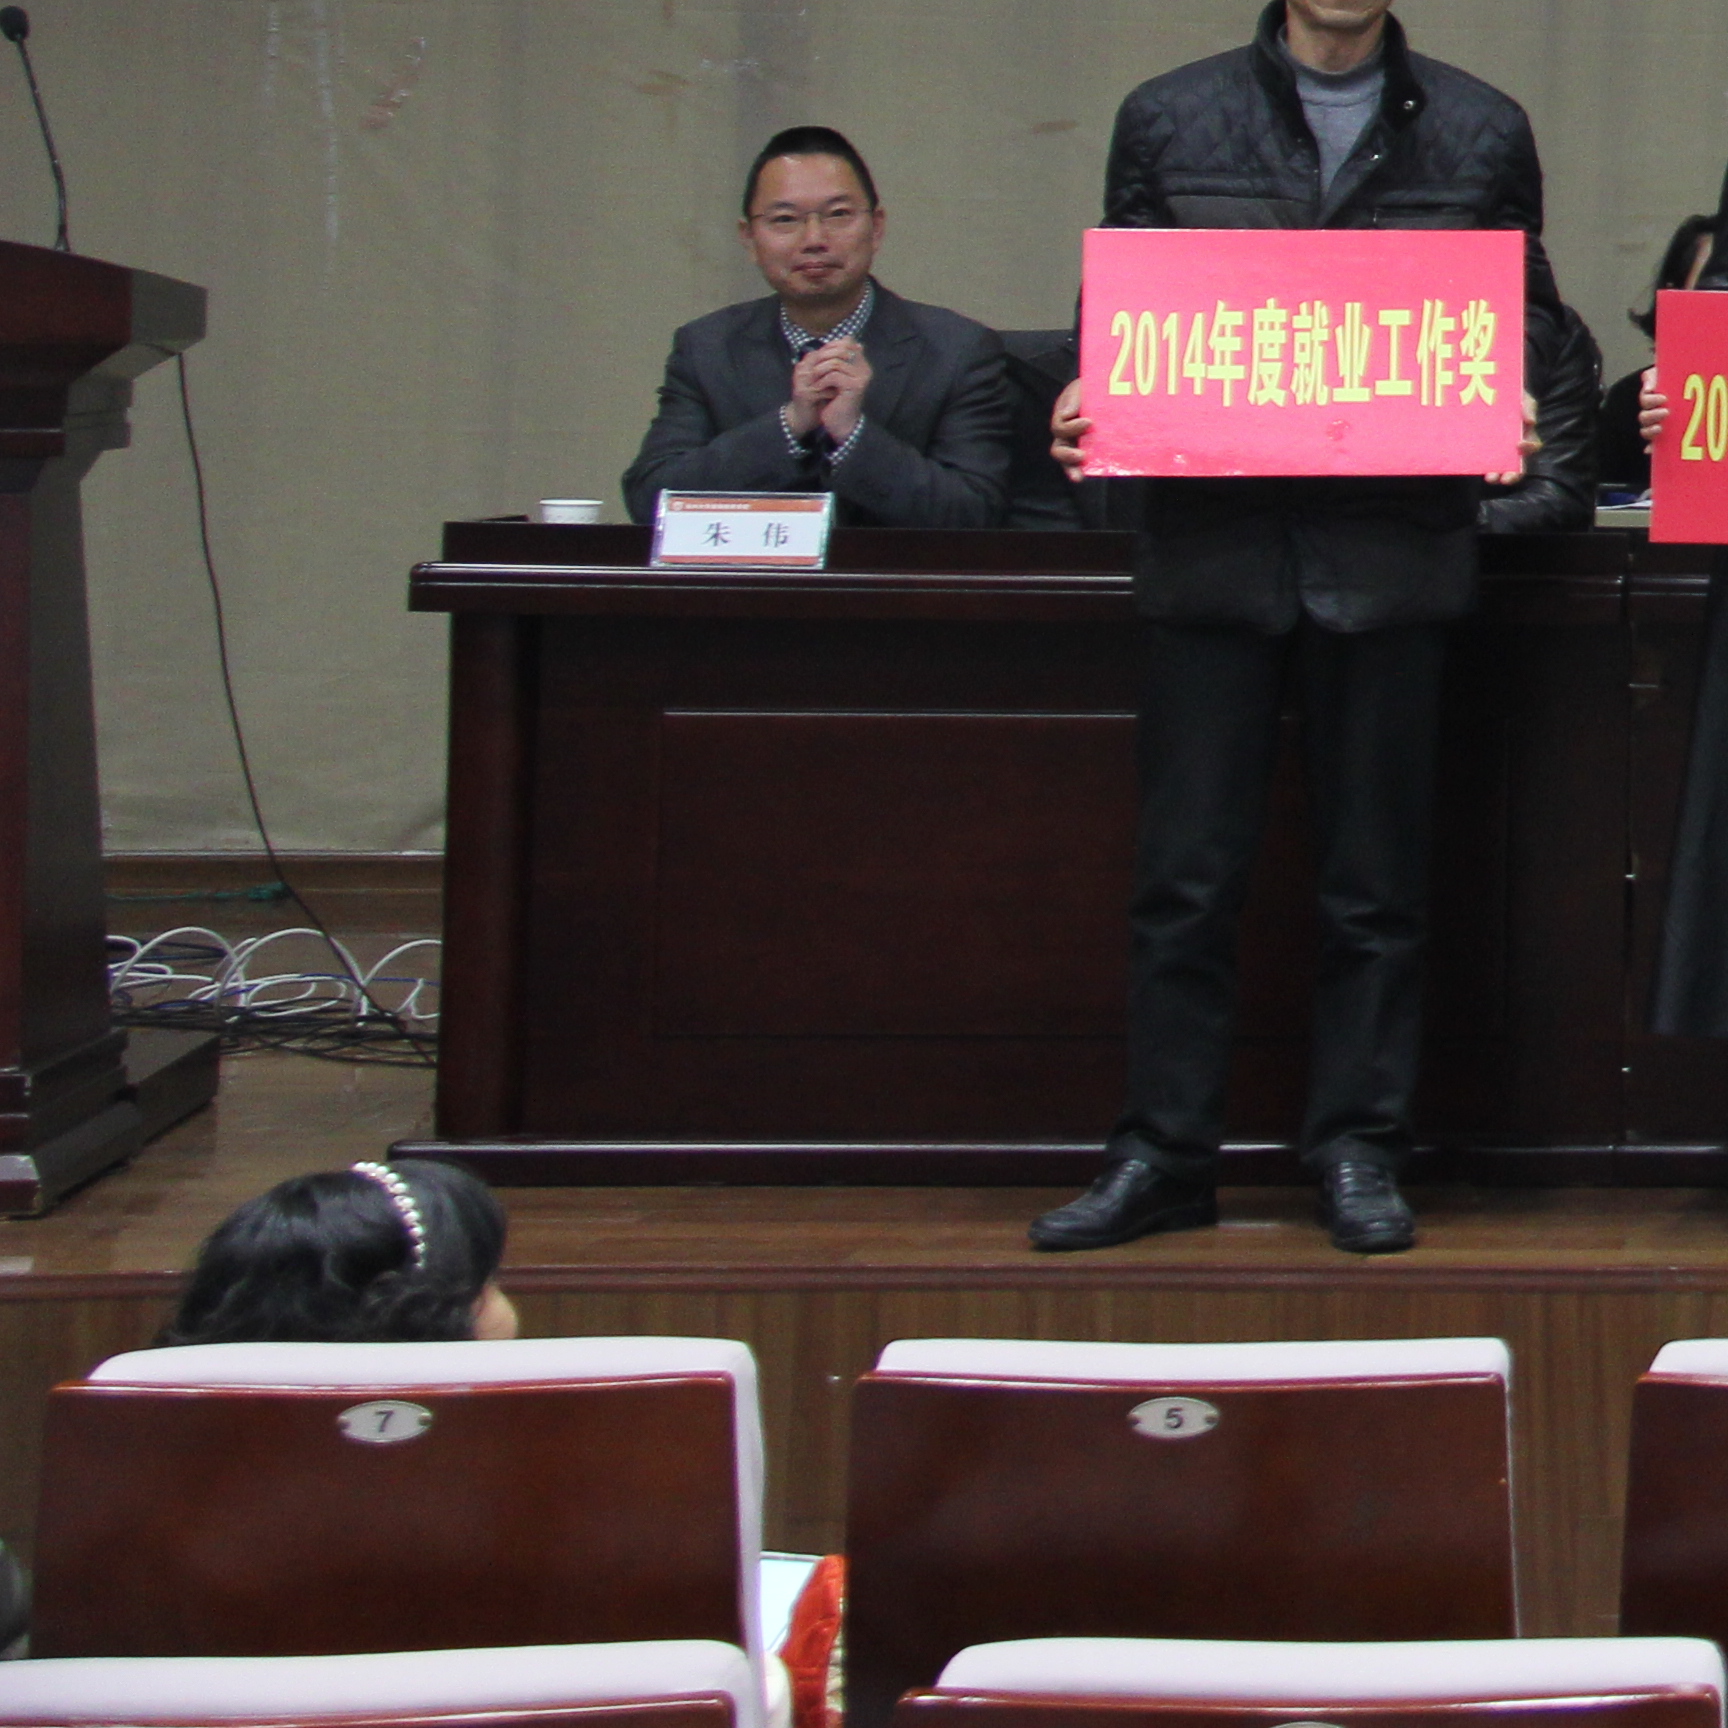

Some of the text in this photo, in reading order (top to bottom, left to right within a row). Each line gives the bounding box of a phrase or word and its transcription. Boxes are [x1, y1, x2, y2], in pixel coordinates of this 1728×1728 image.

[1109, 298, 1496, 407] 2014年度就业工作奖
[375, 1410, 395, 1433] 7
[1165, 1407, 1184, 1430] 5
